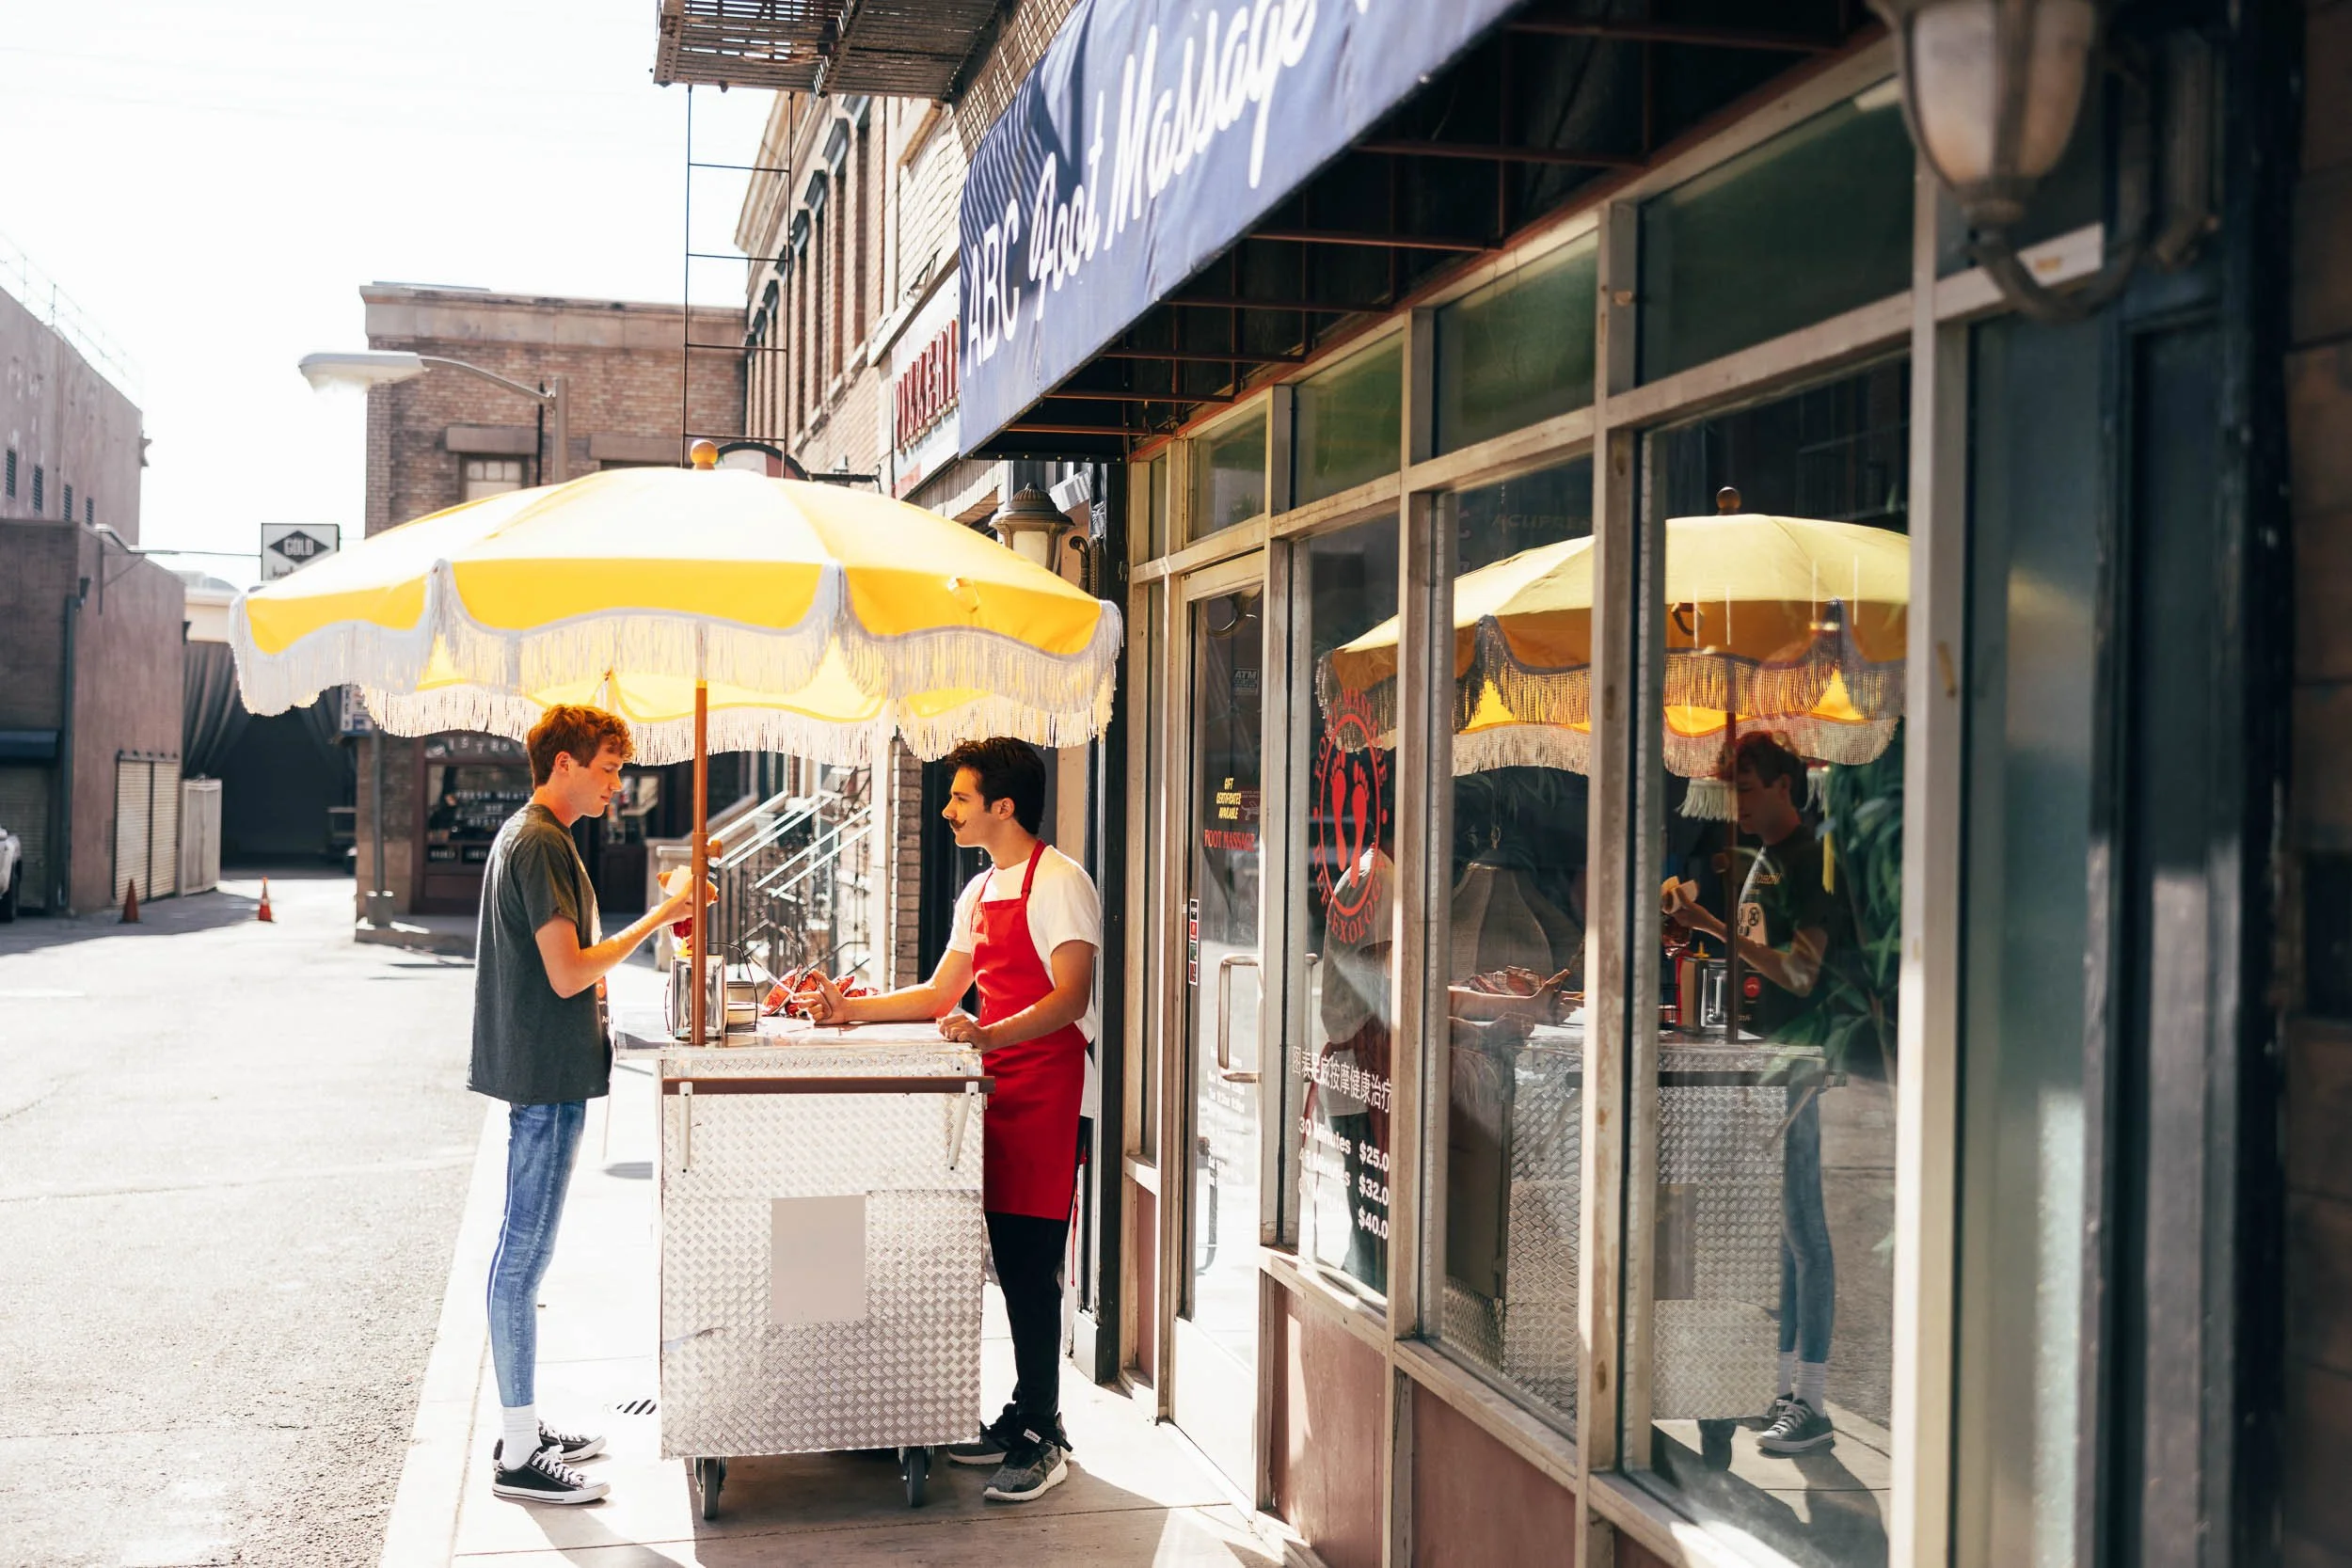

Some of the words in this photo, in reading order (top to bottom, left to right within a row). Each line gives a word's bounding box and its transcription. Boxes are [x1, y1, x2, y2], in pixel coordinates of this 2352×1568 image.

[966, 198, 1020, 377] ABC
[1028, 90, 1104, 322] Foot
[284, 537, 314, 556] GOLD
[1233, 669, 1257, 679] ATM
[1204, 829, 1222, 848] FOOT
[1298, 1116, 1312, 1137] 30
[1313, 1120, 1352, 1155] Minutes
